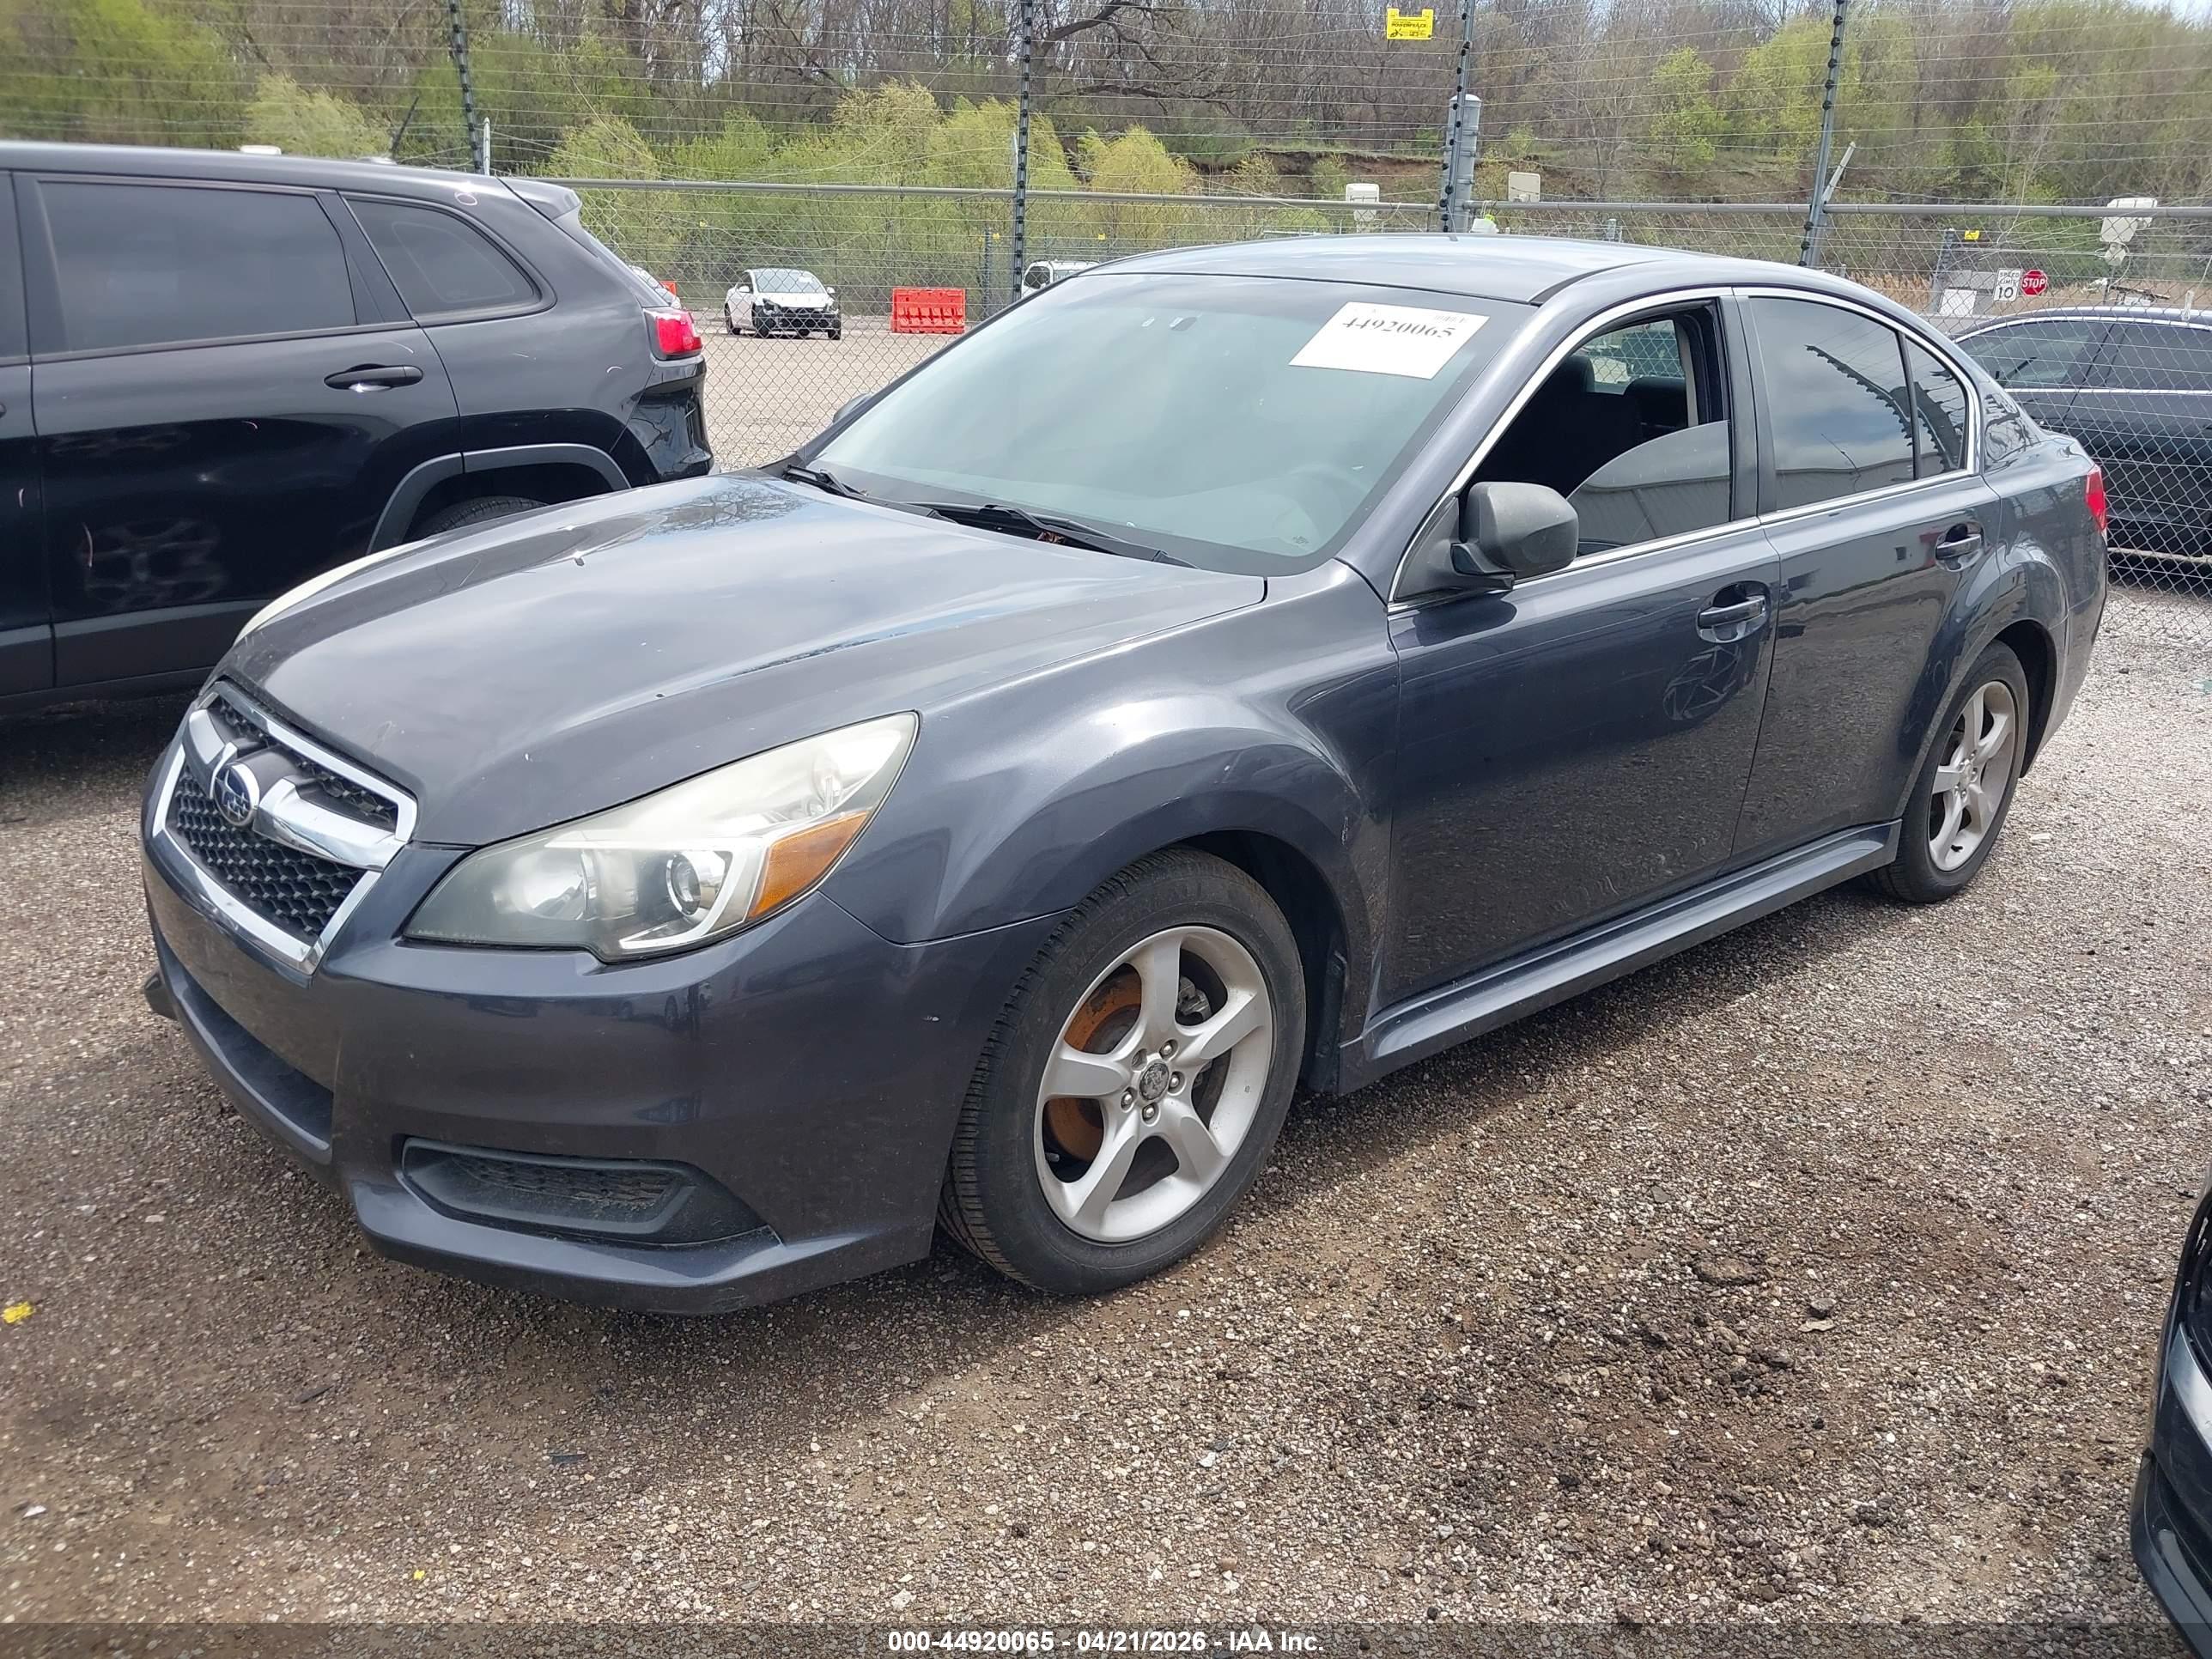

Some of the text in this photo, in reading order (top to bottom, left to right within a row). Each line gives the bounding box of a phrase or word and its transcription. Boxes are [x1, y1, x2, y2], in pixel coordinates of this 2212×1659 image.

[2022, 277, 2045, 289] STOP
[1998, 287, 2014, 299] 10
[1342, 317, 1456, 338] 44920065
